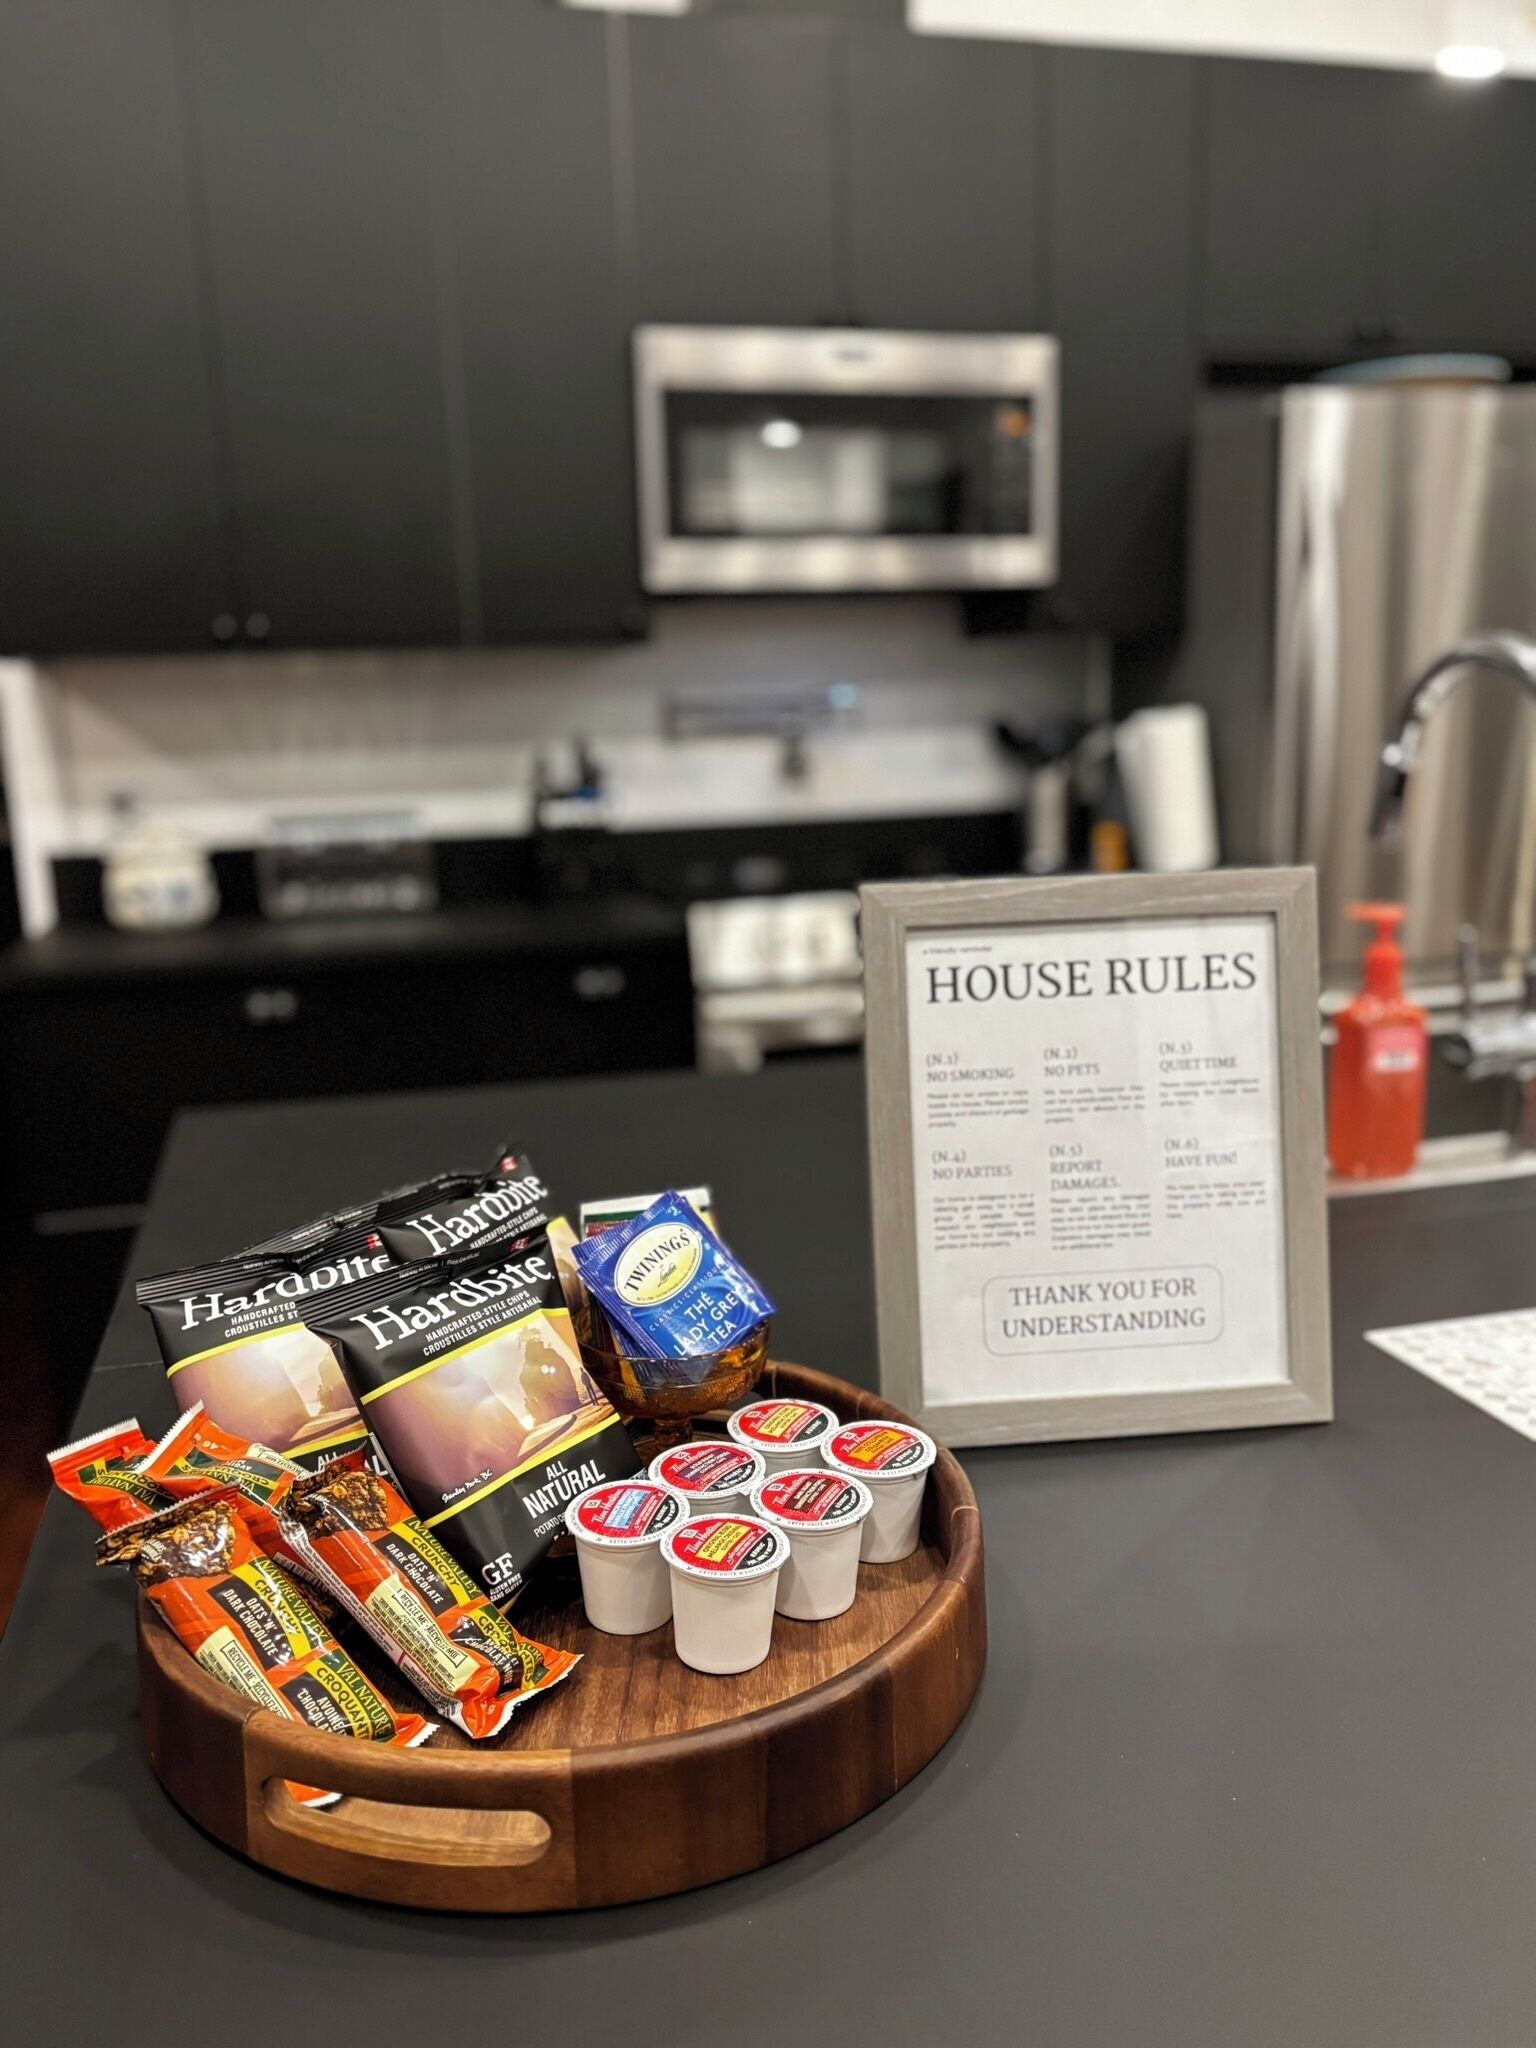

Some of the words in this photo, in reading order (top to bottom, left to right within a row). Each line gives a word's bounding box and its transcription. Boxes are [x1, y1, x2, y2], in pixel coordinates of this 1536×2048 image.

[926, 960, 1093, 1003] HOUSE
[1105, 952, 1256, 995] RULES
[927, 1070, 947, 1083] NO
[950, 1067, 1015, 1082] SMOKING
[1044, 1065, 1065, 1078] NO
[1067, 1063, 1100, 1076] PETS
[1159, 1058, 1199, 1073] QUIET
[1203, 1056, 1237, 1070] TIME
[932, 1168, 954, 1181] NO
[956, 1164, 1013, 1180] PARTIES
[1050, 1159, 1102, 1174] REPORT
[1165, 1153, 1203, 1168] HAVE
[406, 1175, 549, 1256] Hardbite
[623, 1232, 691, 1293] TWININGS
[179, 1254, 391, 1331] Hardbite
[349, 1256, 552, 1351] Hardbite
[683, 1291, 715, 1321] THÉ
[1009, 1284, 1093, 1307] THANK
[1098, 1280, 1146, 1302] YOU
[1151, 1276, 1197, 1298] FOR
[224, 1314, 286, 1339] CROUSTILLES
[422, 1322, 478, 1357] CROUSTILLES
[478, 1311, 502, 1331] STYLE
[501, 1296, 543, 1320] ARTISANAL
[425, 1300, 507, 1342] HANDCRAFTED-STYLE
[507, 1290, 531, 1308] CHIPS
[1002, 1308, 1206, 1339] UNDERSTANDING
[673, 1322, 710, 1357] LADY
[707, 1318, 738, 1347] TEA
[545, 1460, 569, 1481] ALL
[133, 1486, 157, 1505] VAL
[522, 1459, 607, 1520] NATURAL
[533, 1517, 561, 1538] POTATO
[407, 1551, 427, 1573] OATS
[408, 1517, 450, 1559] NATURE
[447, 1553, 481, 1597] VALLEY
[411, 1535, 461, 1590] CRUNCHY
[481, 1552, 515, 1586] GF
[258, 1558, 296, 1602] NATURE
[385, 1543, 408, 1564] DARK
[404, 1560, 445, 1606] CHOCOLATE
[222, 1588, 242, 1614] DARK
[239, 1610, 279, 1657] CHOCOLATE
[246, 1597, 267, 1620] OATS
[227, 1647, 248, 1672] RECYCLE
[464, 1637, 505, 1666] CHOCOLAT
[317, 1696, 345, 1732] AVOINE
[337, 1662, 356, 1689] VAL
[354, 1686, 392, 1737] NATURE
